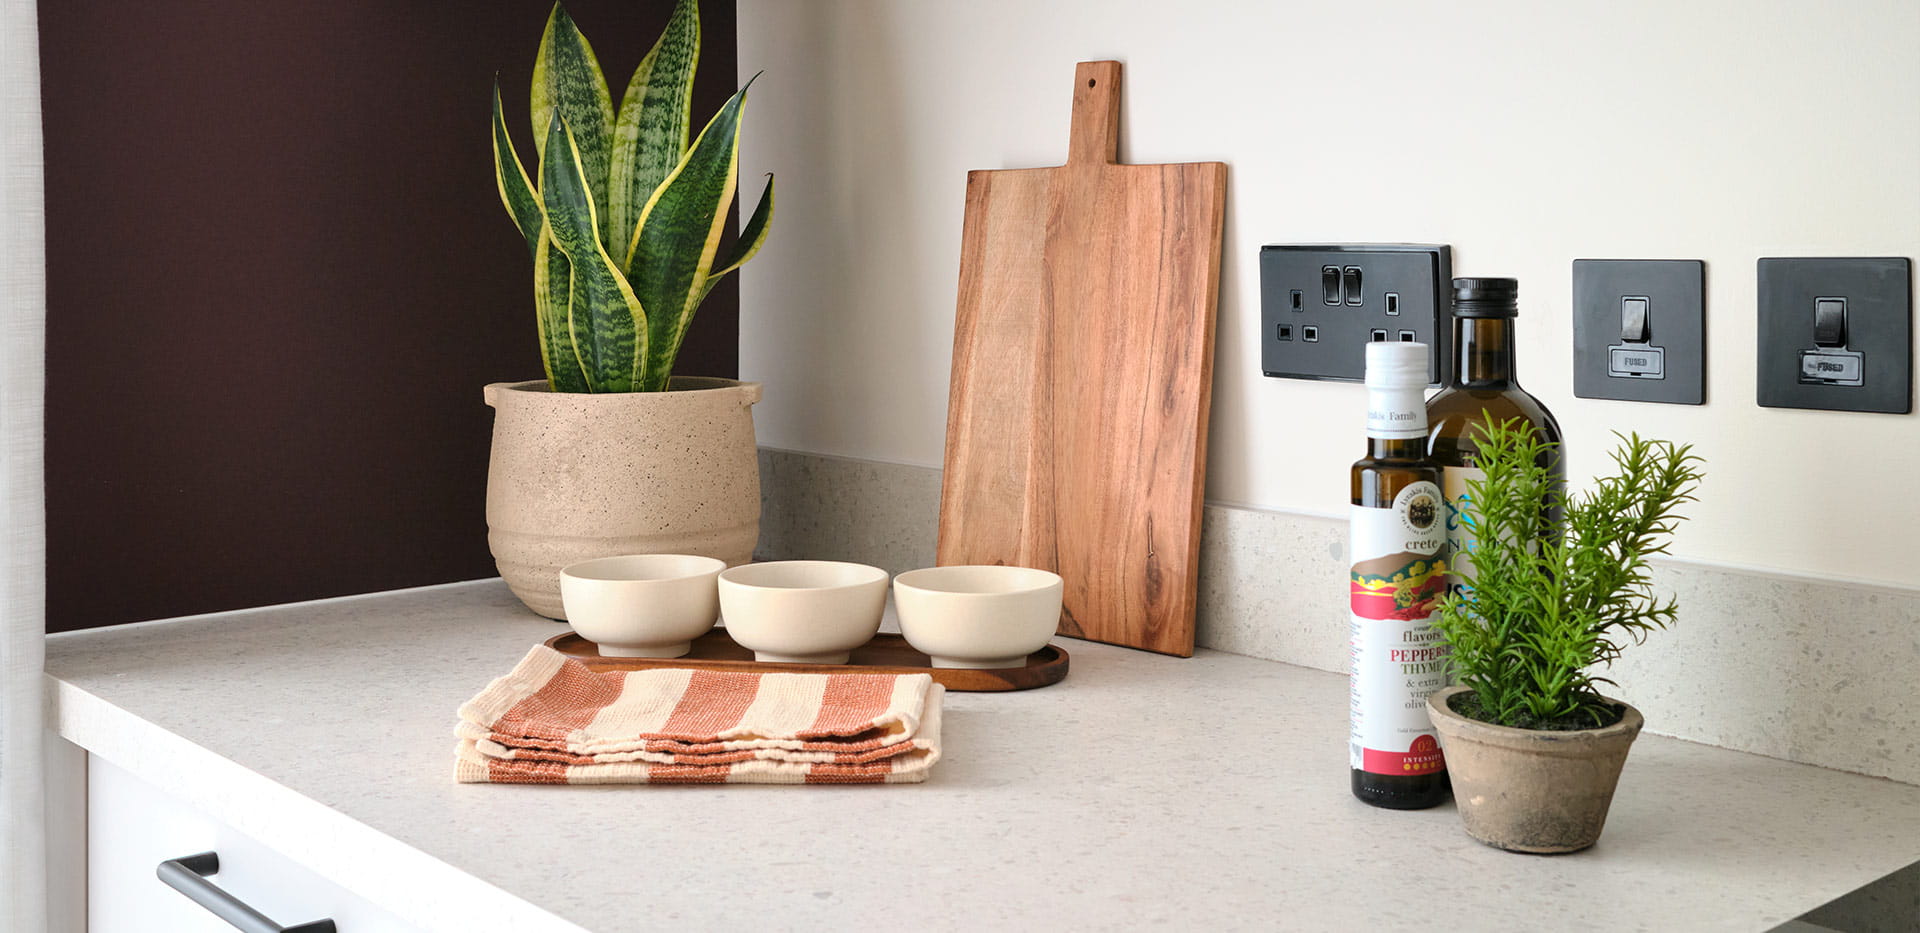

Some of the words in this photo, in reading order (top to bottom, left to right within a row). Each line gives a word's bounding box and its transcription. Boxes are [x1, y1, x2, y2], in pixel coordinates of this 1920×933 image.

[1624, 357, 1648, 367] FUSED
[1817, 361, 1844, 373] FUSED
[1405, 539, 1439, 550] crete
[1403, 630, 1441, 642] flavors
[1400, 661, 1441, 674] THYME
[1406, 679, 1415, 688] &
[1417, 679, 1440, 688] extra
[1410, 687, 1434, 701] virgi
